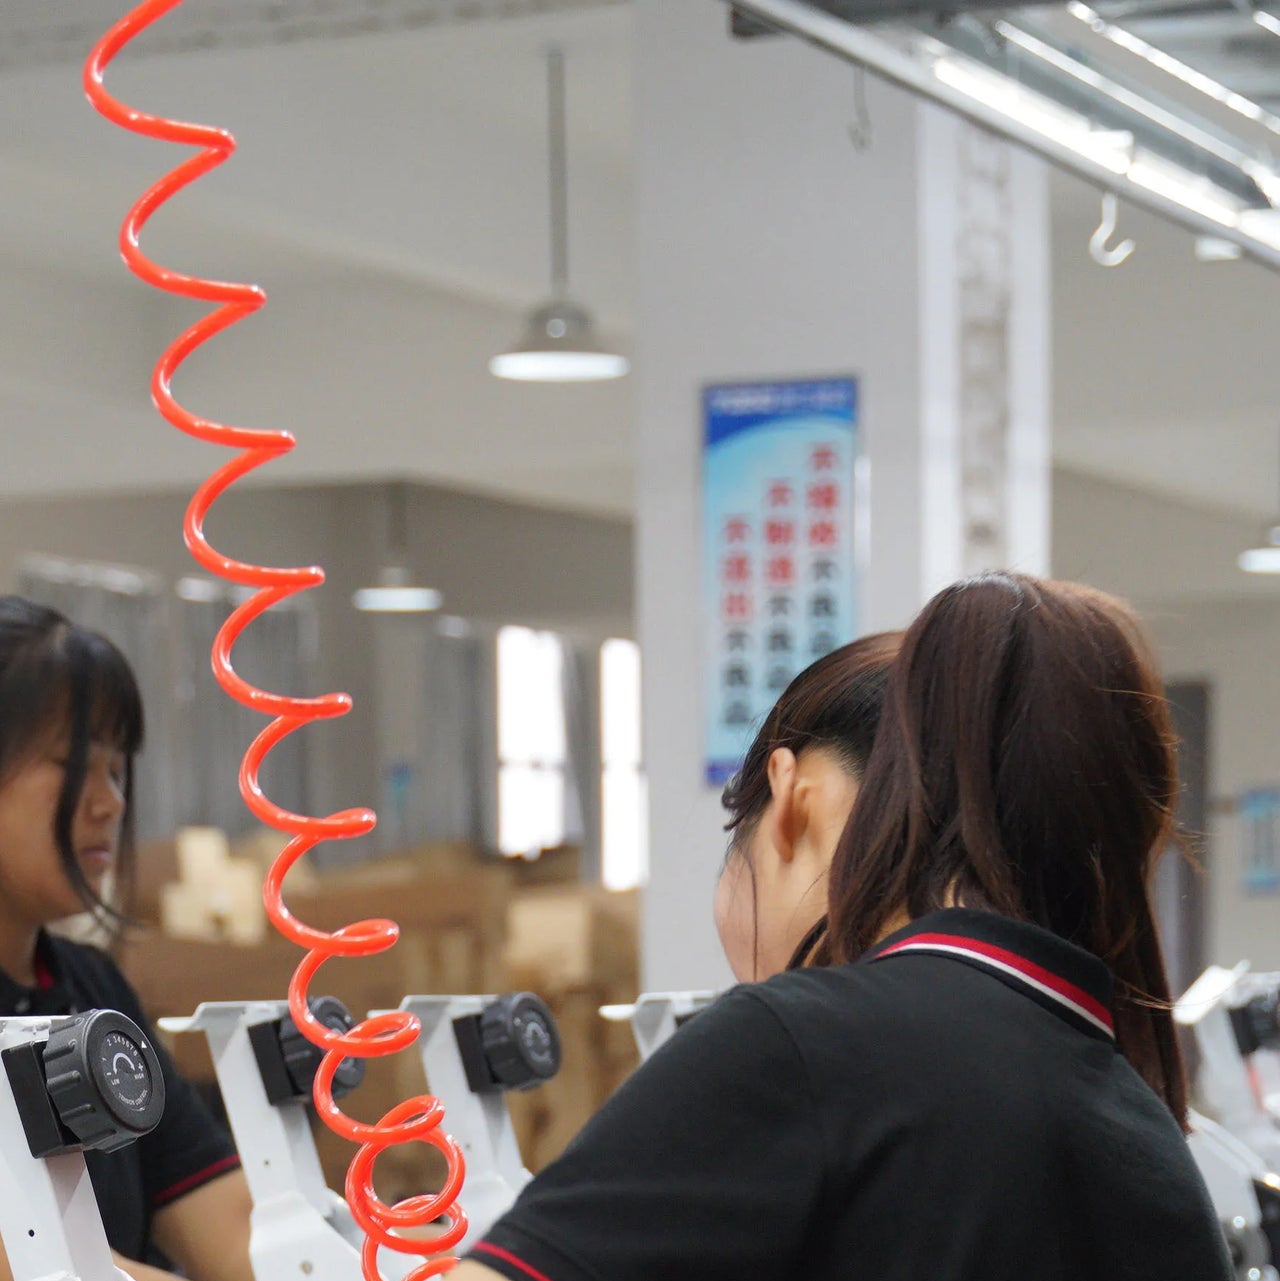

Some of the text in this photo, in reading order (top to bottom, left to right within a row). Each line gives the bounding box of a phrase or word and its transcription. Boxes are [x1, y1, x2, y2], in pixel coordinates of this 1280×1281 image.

[107, 1038, 112, 1047] 2
[113, 1035, 117, 1043] 3
[121, 1037, 125, 1045] 5
[125, 1040, 130, 1048] 6
[111, 1072, 144, 1086] LOW HIGH
